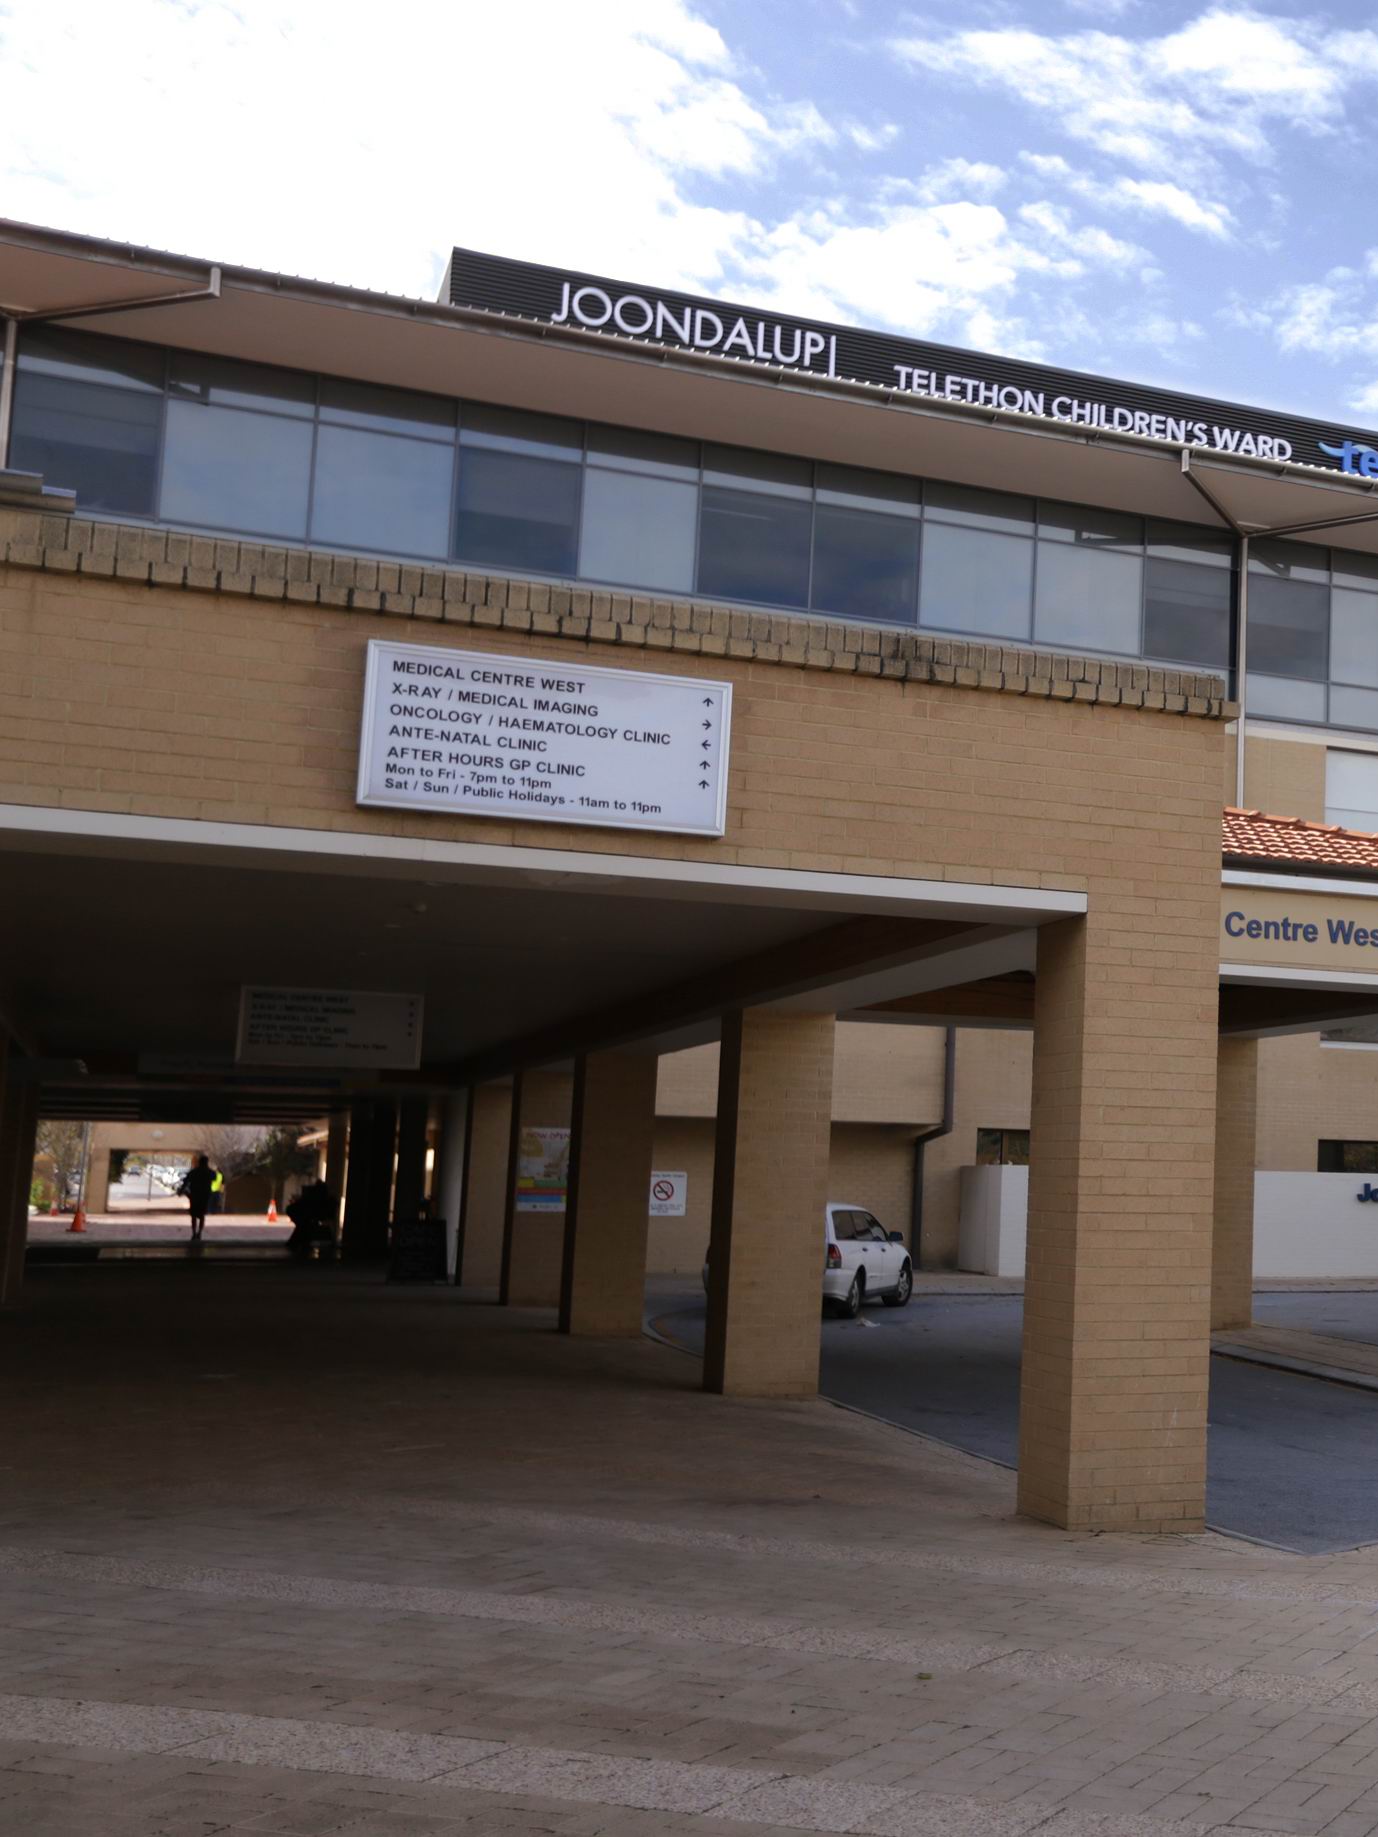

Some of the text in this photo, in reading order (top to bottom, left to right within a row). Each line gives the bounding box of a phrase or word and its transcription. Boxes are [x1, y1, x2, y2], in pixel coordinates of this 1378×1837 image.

[893, 365, 1292, 461] TELETHON CHILDREN'S WARD
[393, 660, 585, 694] MEDICAL CENTRE WEST
[392, 682, 442, 700] X-RAY
[458, 690, 528, 709] MEDICAL
[533, 699, 599, 717] IMAGING
[389, 725, 547, 753] ANTE-NATAL CLINIC
[390, 704, 482, 725] ONCOLOGY
[499, 716, 618, 740] HAEMATOLOGY
[623, 729, 671, 745] CLINIC
[385, 763, 415, 776] Mon
[420, 766, 434, 778] to
[438, 768, 456, 780] Fri
[469, 771, 497, 784] 7pm
[502, 775, 515, 786] to
[520, 777, 552, 789] 11pm
[387, 746, 586, 777] AFTER HOURS GP CLINIC
[385, 778, 409, 790] Sat
[423, 781, 449, 794] Sun
[463, 785, 504, 799] Public
[508, 790, 566, 806] Holidays
[579, 797, 609, 809] 11am
[614, 800, 627, 811] to
[631, 802, 662, 814] 11pm
[1224, 911, 1318, 943] Centre
